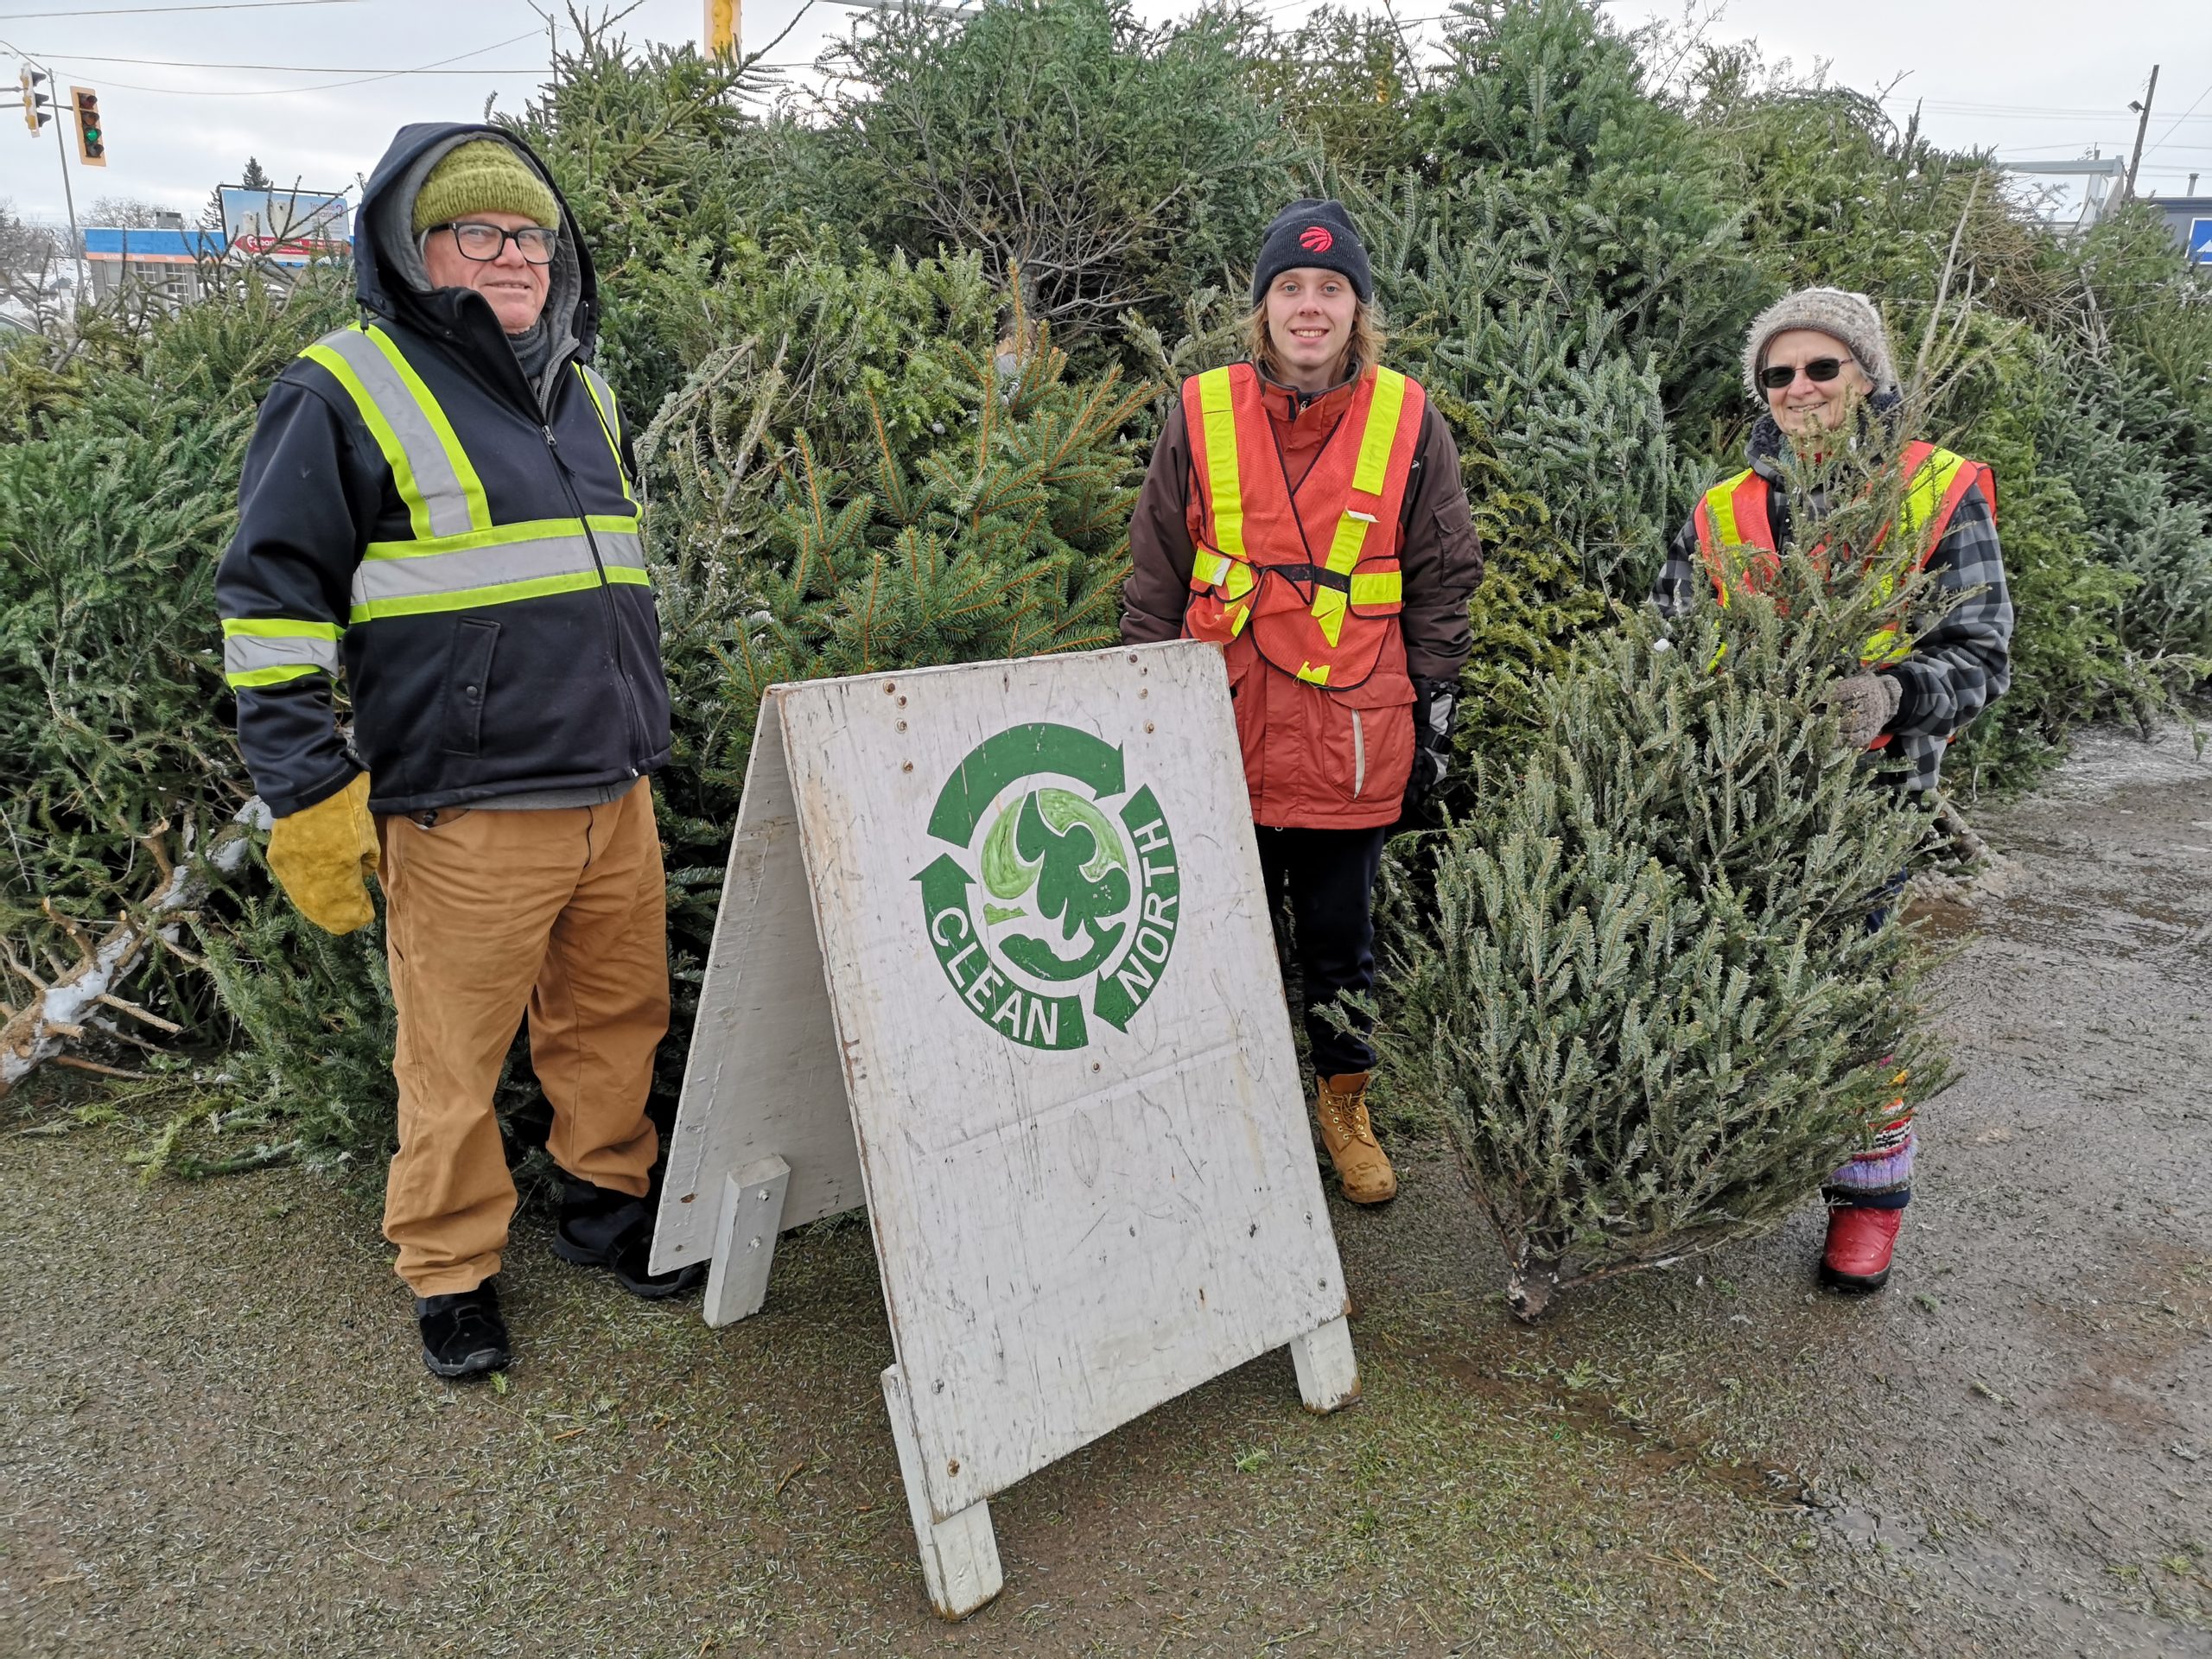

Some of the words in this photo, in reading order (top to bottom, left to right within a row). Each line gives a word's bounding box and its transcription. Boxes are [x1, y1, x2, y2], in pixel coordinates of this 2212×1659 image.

[310, 201, 335, 211] Troble
[931, 906, 1058, 1046] CLEAN
[1117, 817, 1178, 1006] NORTH
